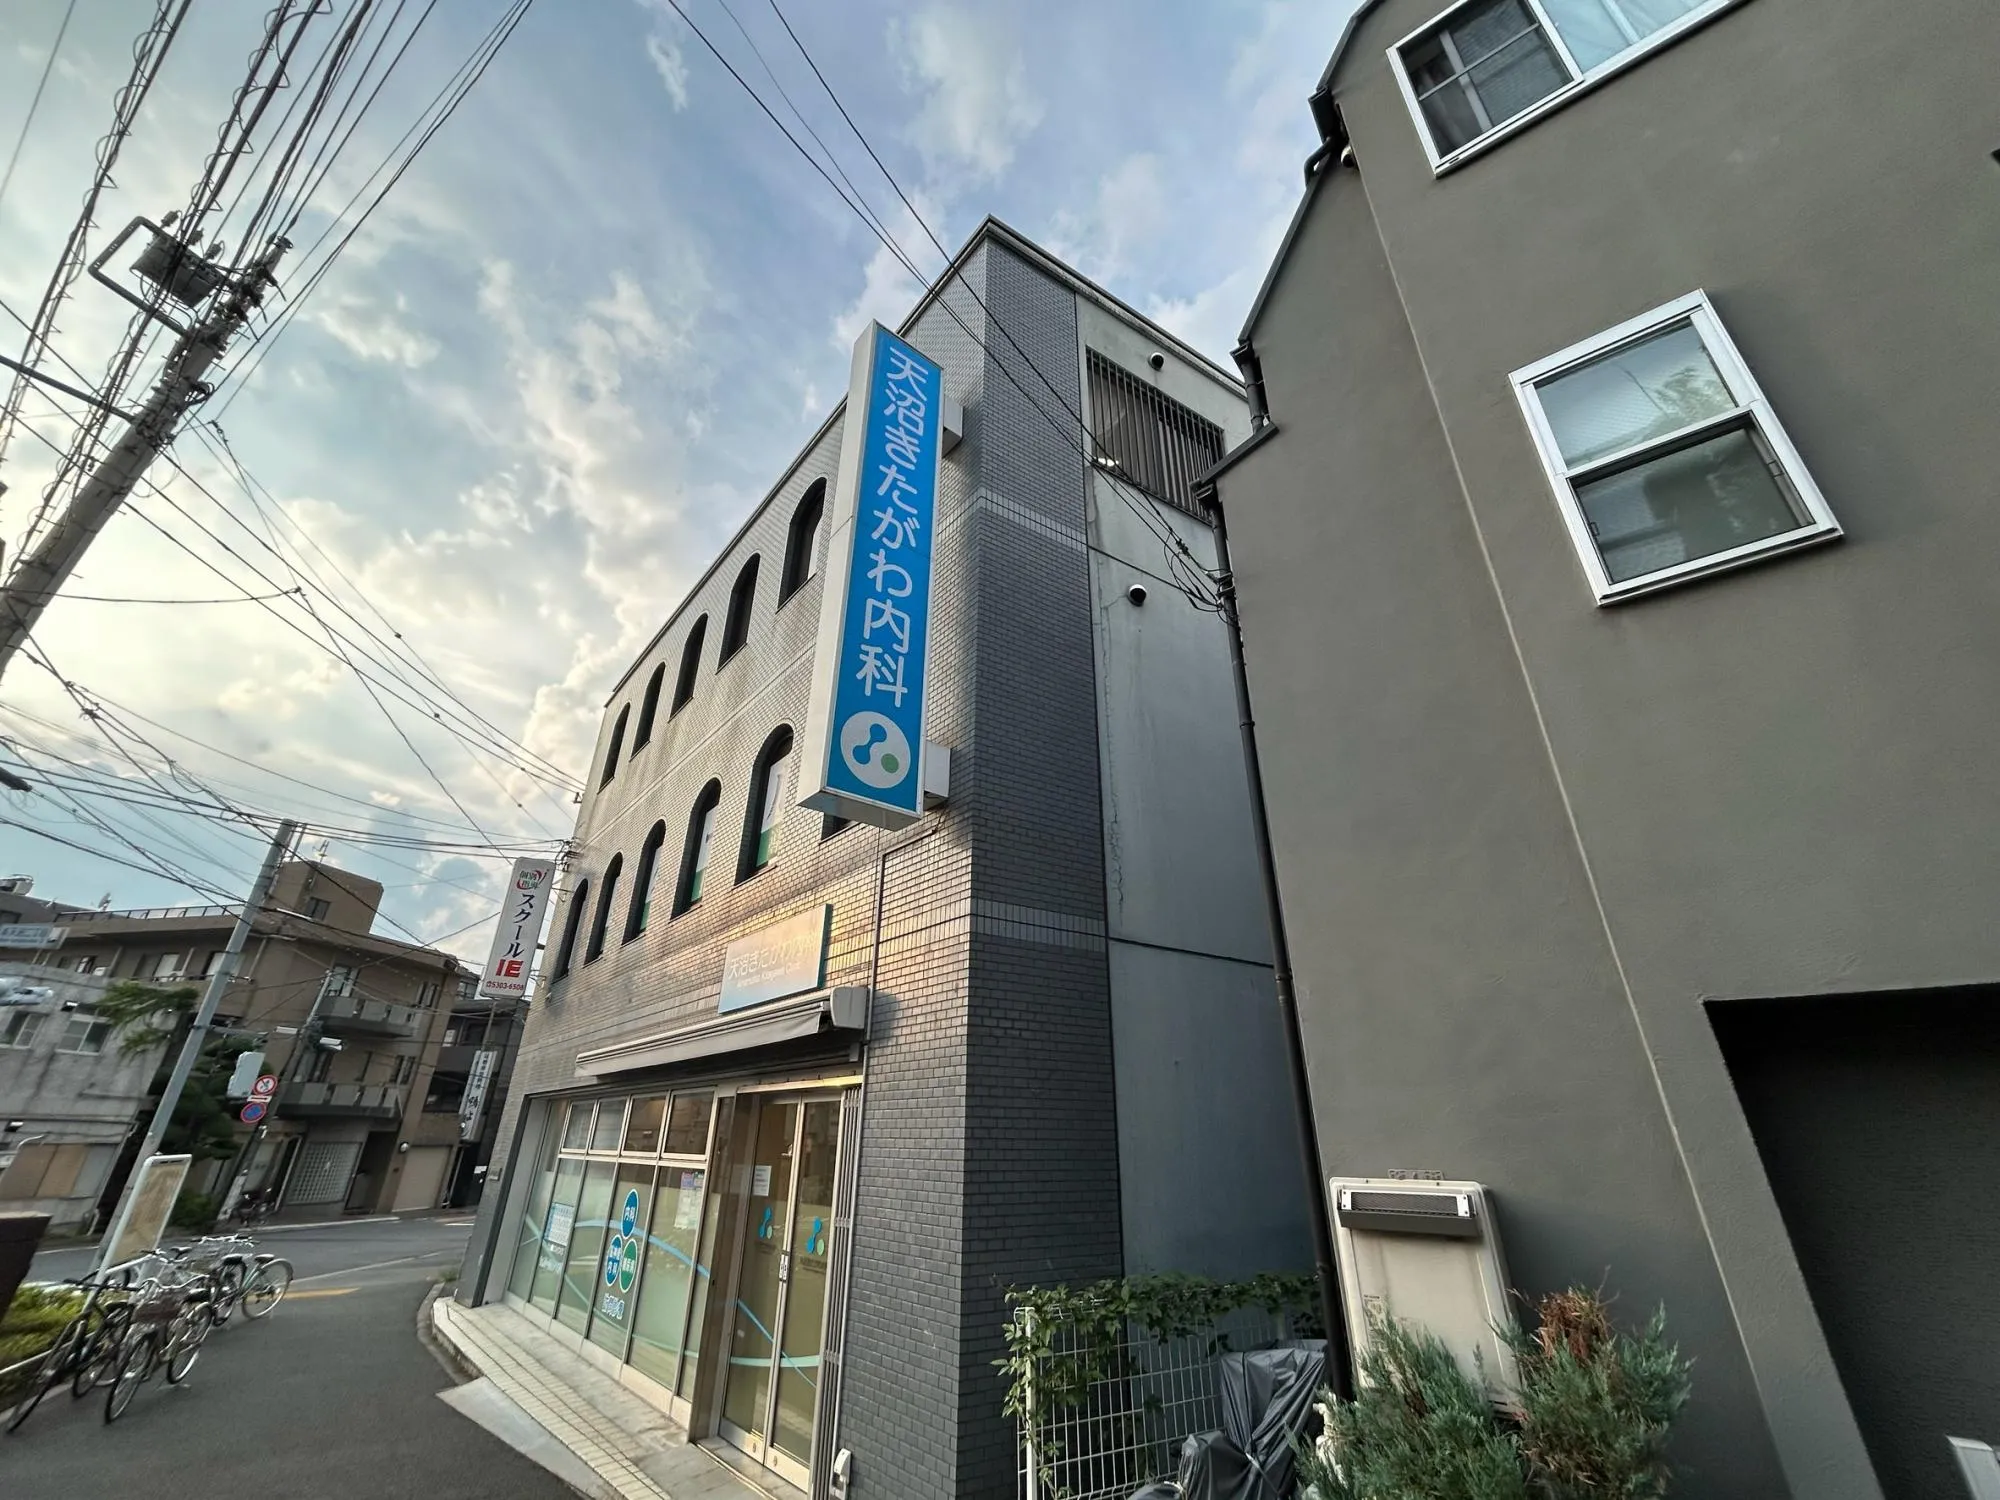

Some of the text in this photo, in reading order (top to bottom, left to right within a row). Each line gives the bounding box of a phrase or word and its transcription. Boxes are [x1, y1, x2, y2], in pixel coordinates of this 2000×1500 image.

[856, 346, 929, 708] 天沼きたがわ内科
[502, 893, 535, 958] スクール
[495, 959, 524, 978] IE
